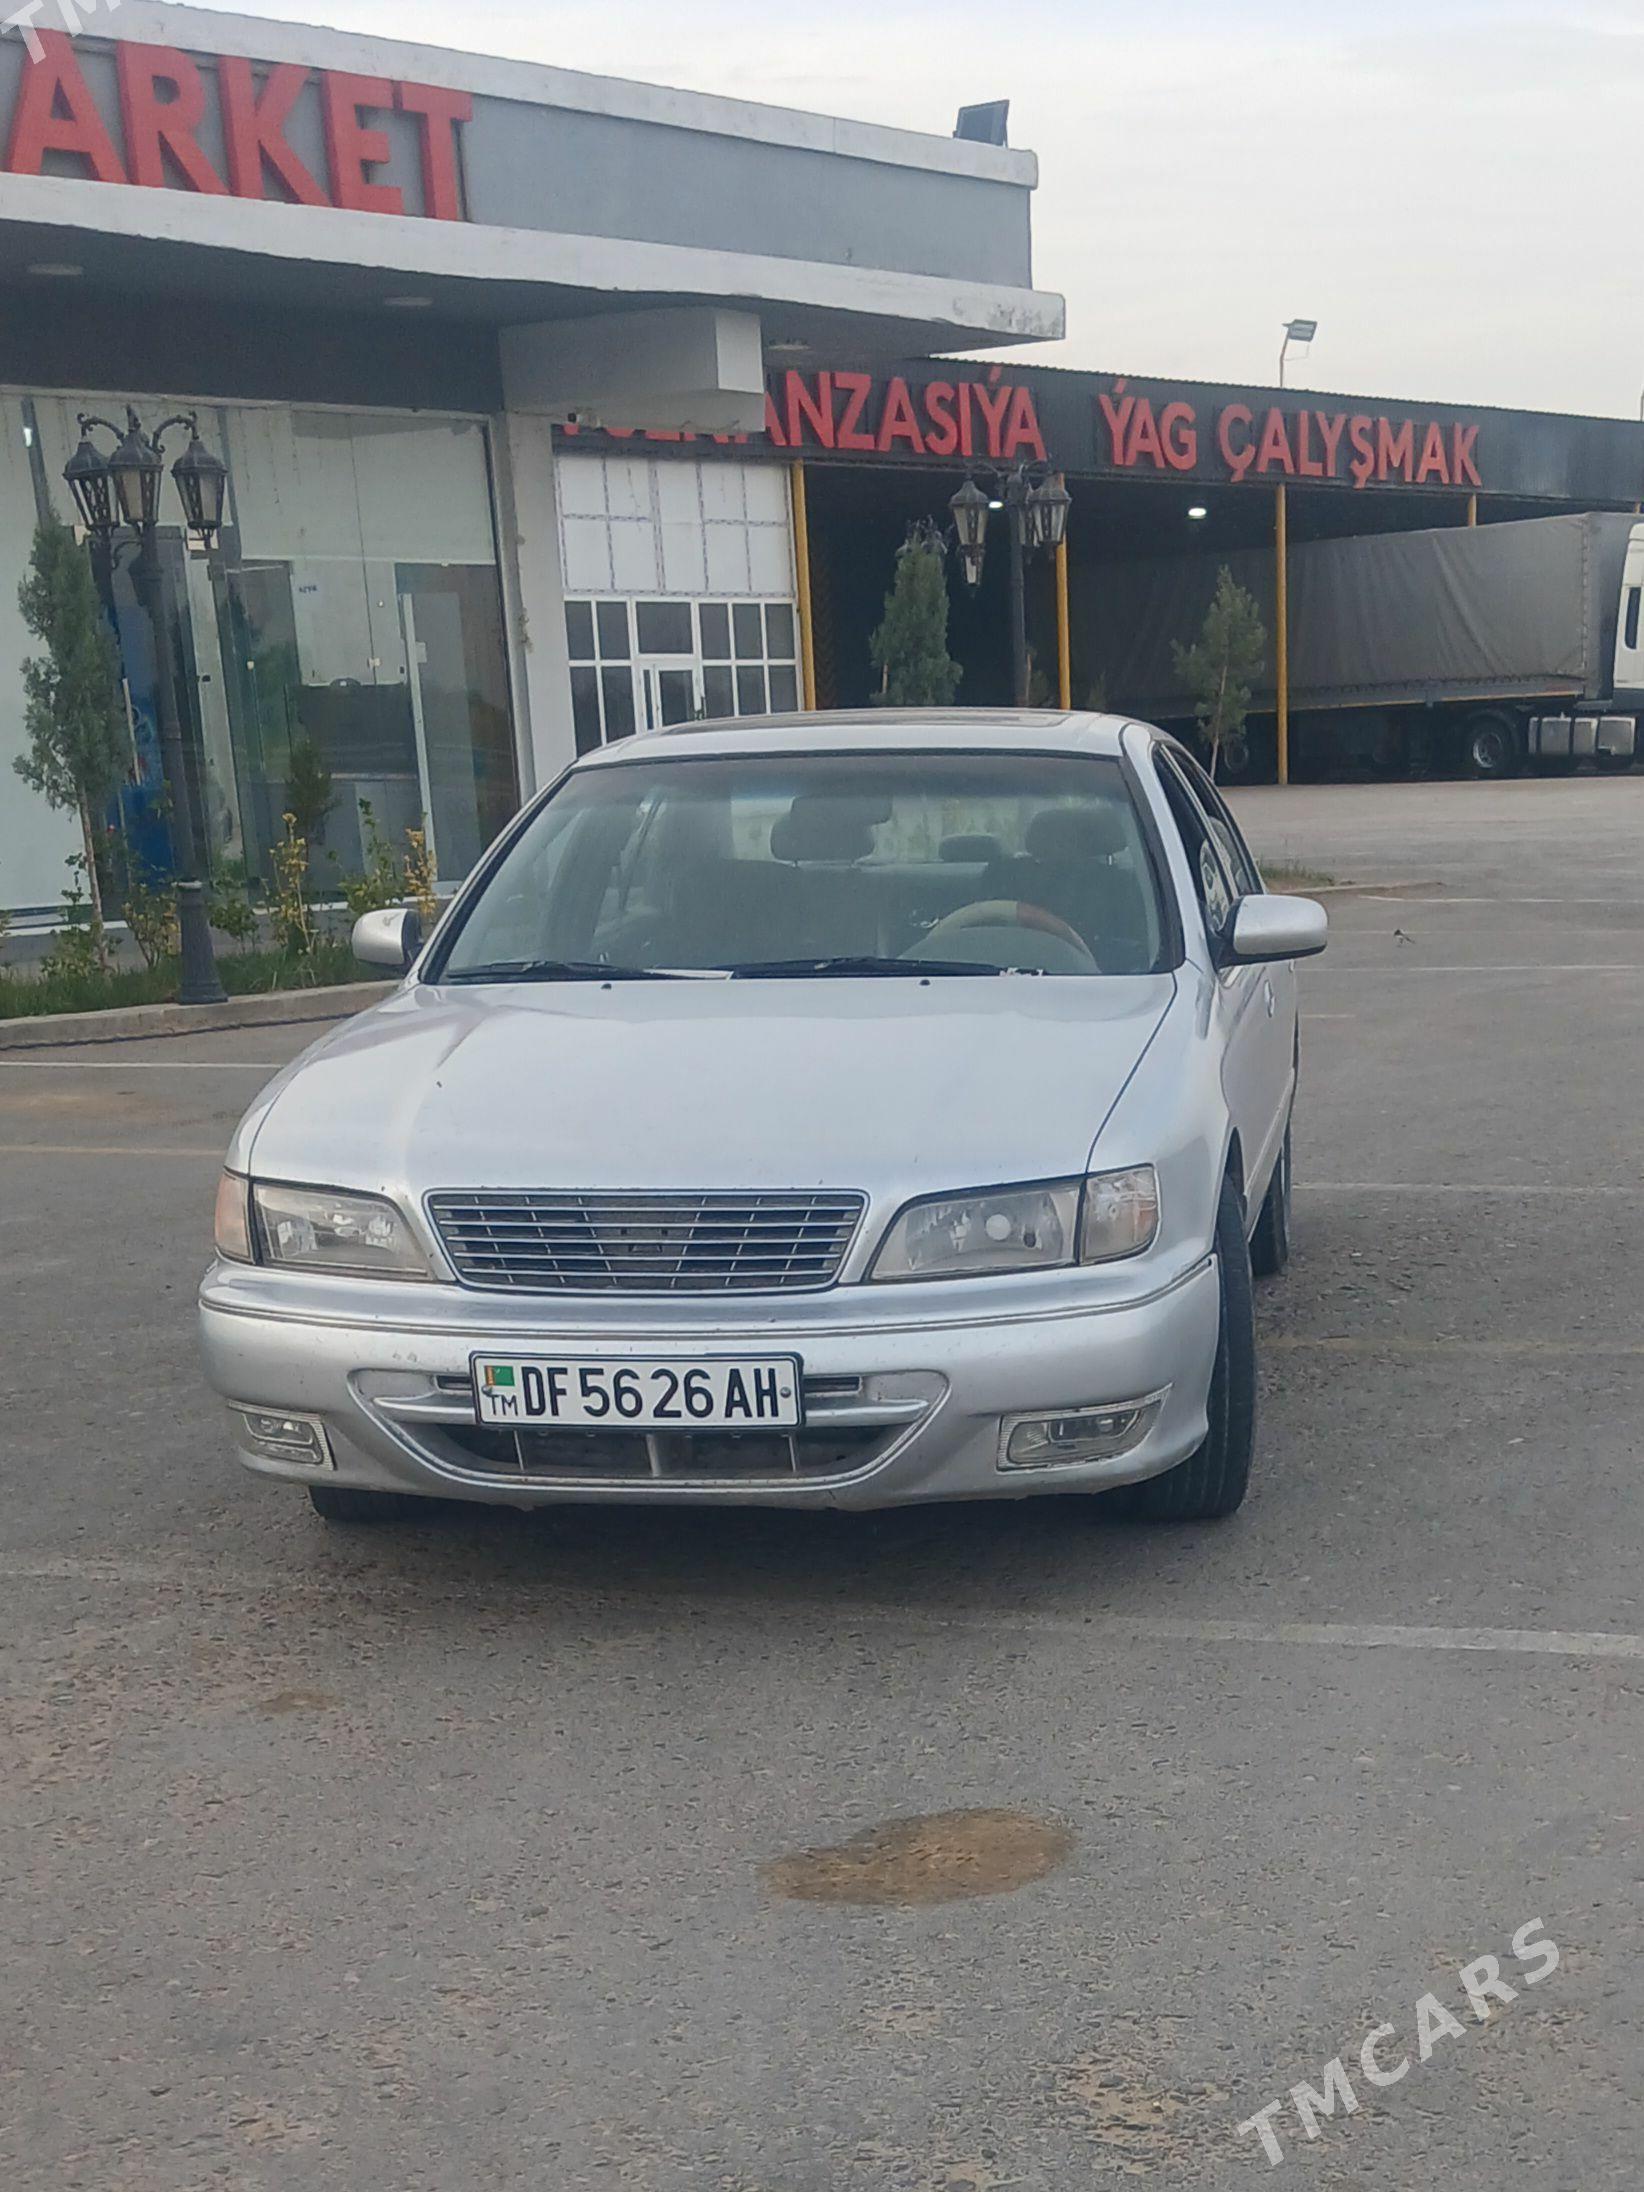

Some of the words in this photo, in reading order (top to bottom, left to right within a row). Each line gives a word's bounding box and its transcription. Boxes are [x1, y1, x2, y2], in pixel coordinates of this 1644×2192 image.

[4, 27, 473, 222] ARKET
[1099, 378, 1197, 471] ÝAG
[1218, 403, 1482, 489] ÇALYŞMAK
